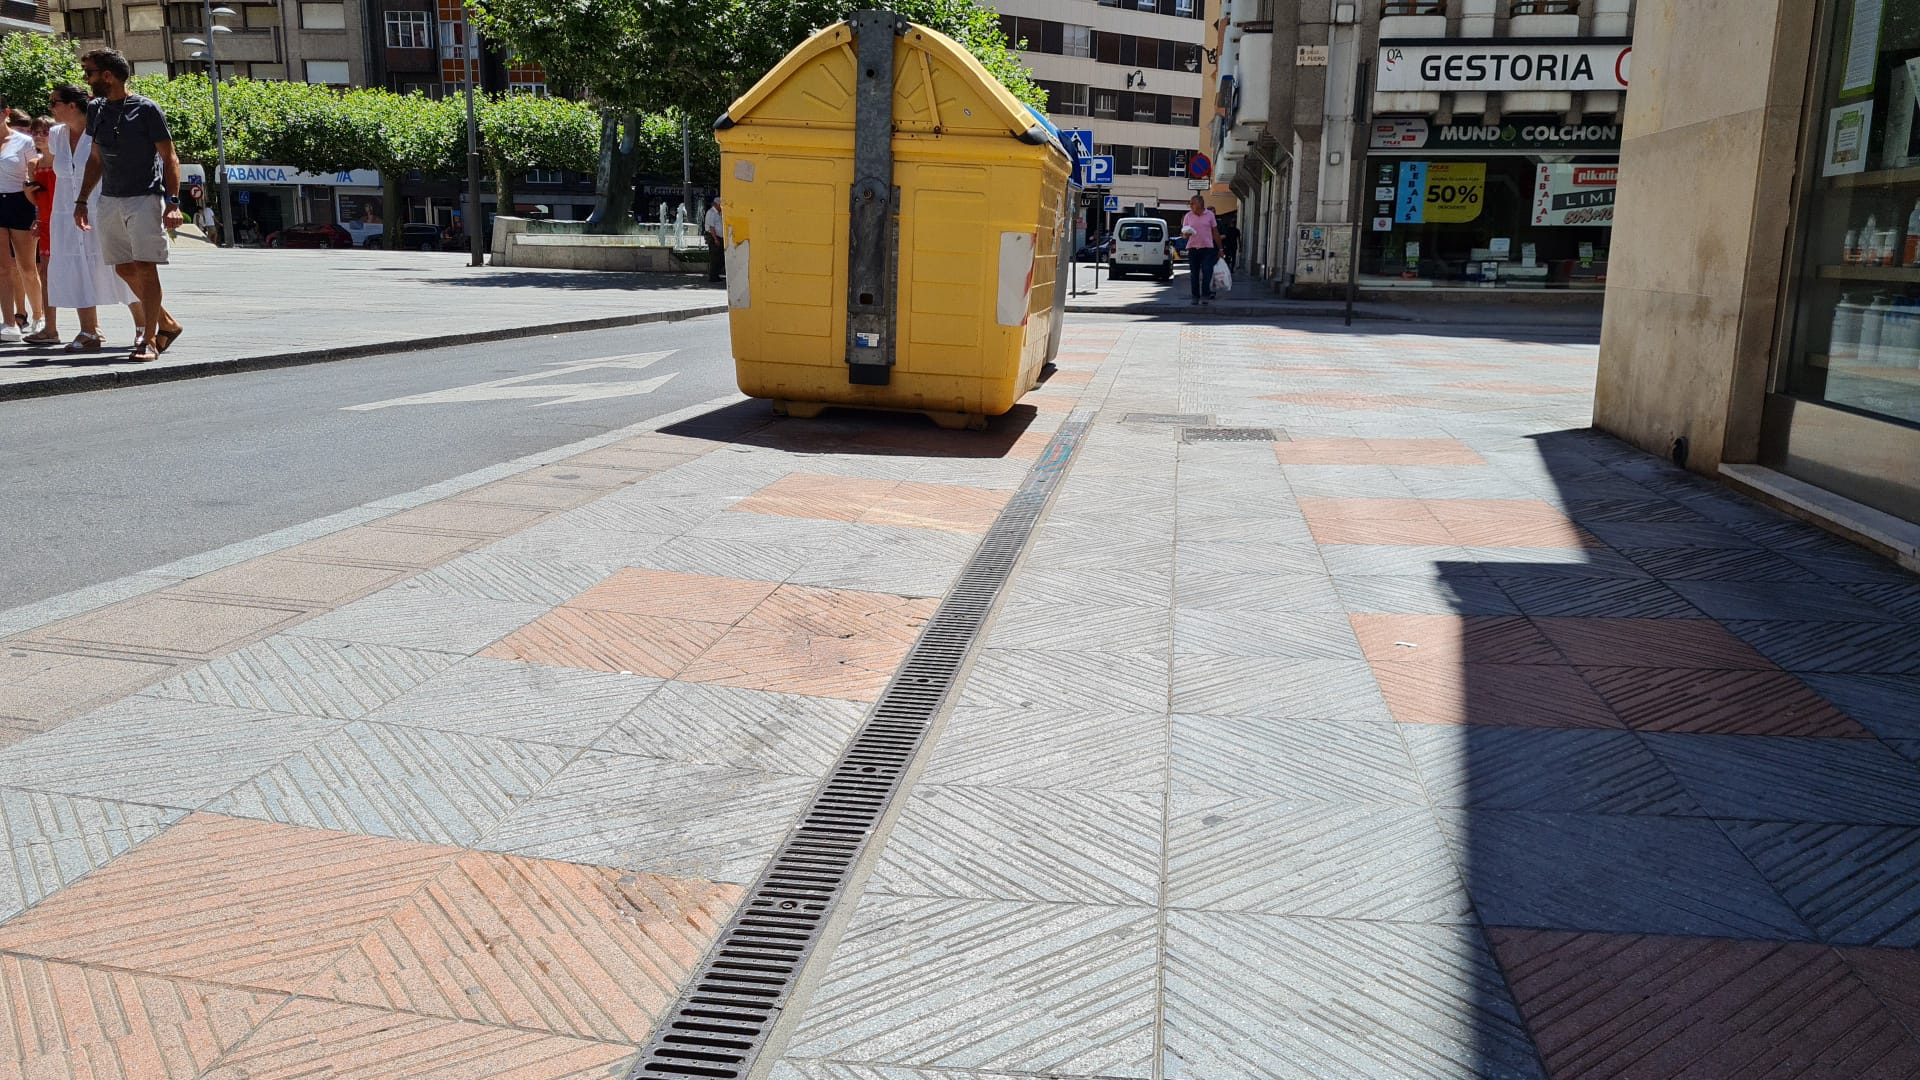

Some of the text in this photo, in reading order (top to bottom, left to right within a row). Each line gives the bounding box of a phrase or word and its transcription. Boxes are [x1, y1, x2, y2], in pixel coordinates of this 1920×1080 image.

[1420, 54, 1594, 81] GESTORIA
[1440, 124, 1617, 141] MUNDO COLCHON
[1091, 158, 1108, 181] P
[1405, 164, 1419, 221] REBAJAS
[1536, 166, 1551, 224] REBAJAS
[1566, 191, 1613, 206] LIMI
